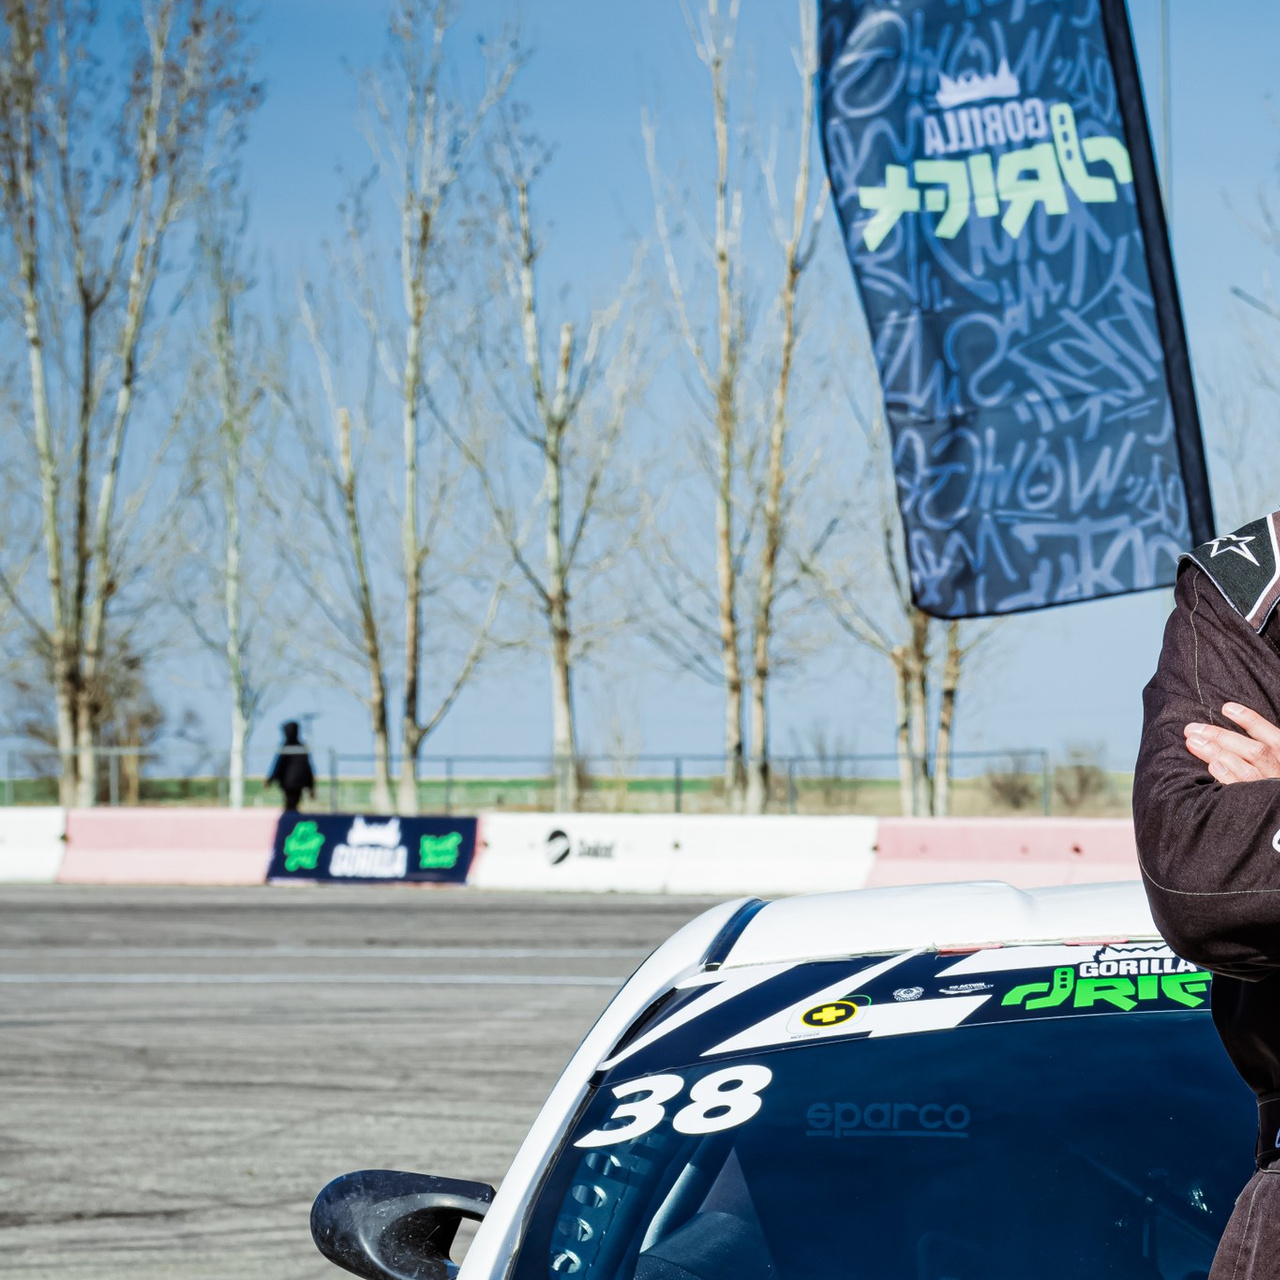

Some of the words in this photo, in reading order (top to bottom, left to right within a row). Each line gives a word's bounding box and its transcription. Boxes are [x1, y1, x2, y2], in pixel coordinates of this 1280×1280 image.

[1079, 958, 1197, 978] GORILLA
[573, 1064, 773, 1148] 38
[806, 1102, 971, 1138] sparco
